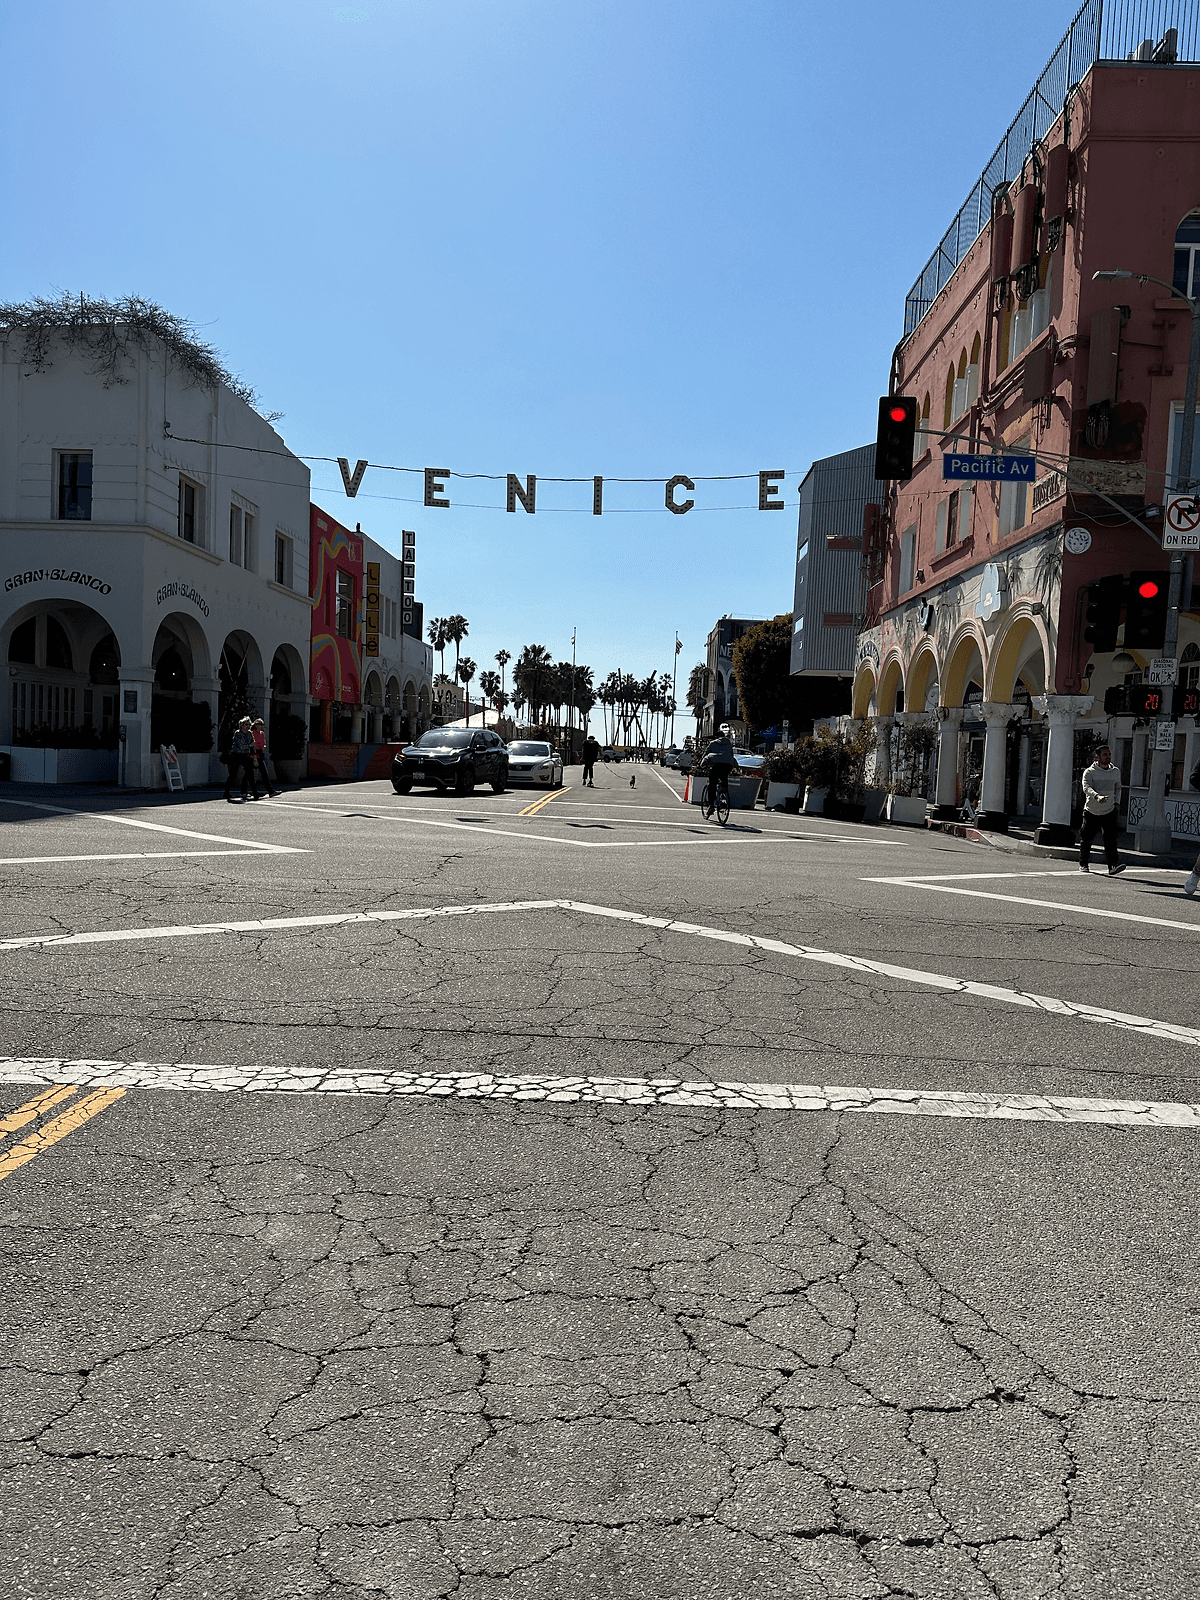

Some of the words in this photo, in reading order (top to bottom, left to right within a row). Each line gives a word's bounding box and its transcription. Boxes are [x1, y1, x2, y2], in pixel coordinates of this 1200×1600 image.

[951, 459, 1005, 474] Pacific
[1010, 461, 1029, 475] Av
[337, 457, 785, 515] VENICE
[1166, 535, 1178, 545] ON
[1181, 536, 1198, 545] RED
[403, 532, 414, 624] TATTOO
[1151, 672, 1160, 682] OK
[1145, 694, 1159, 710] 20
[1184, 694, 1197, 710] 20
